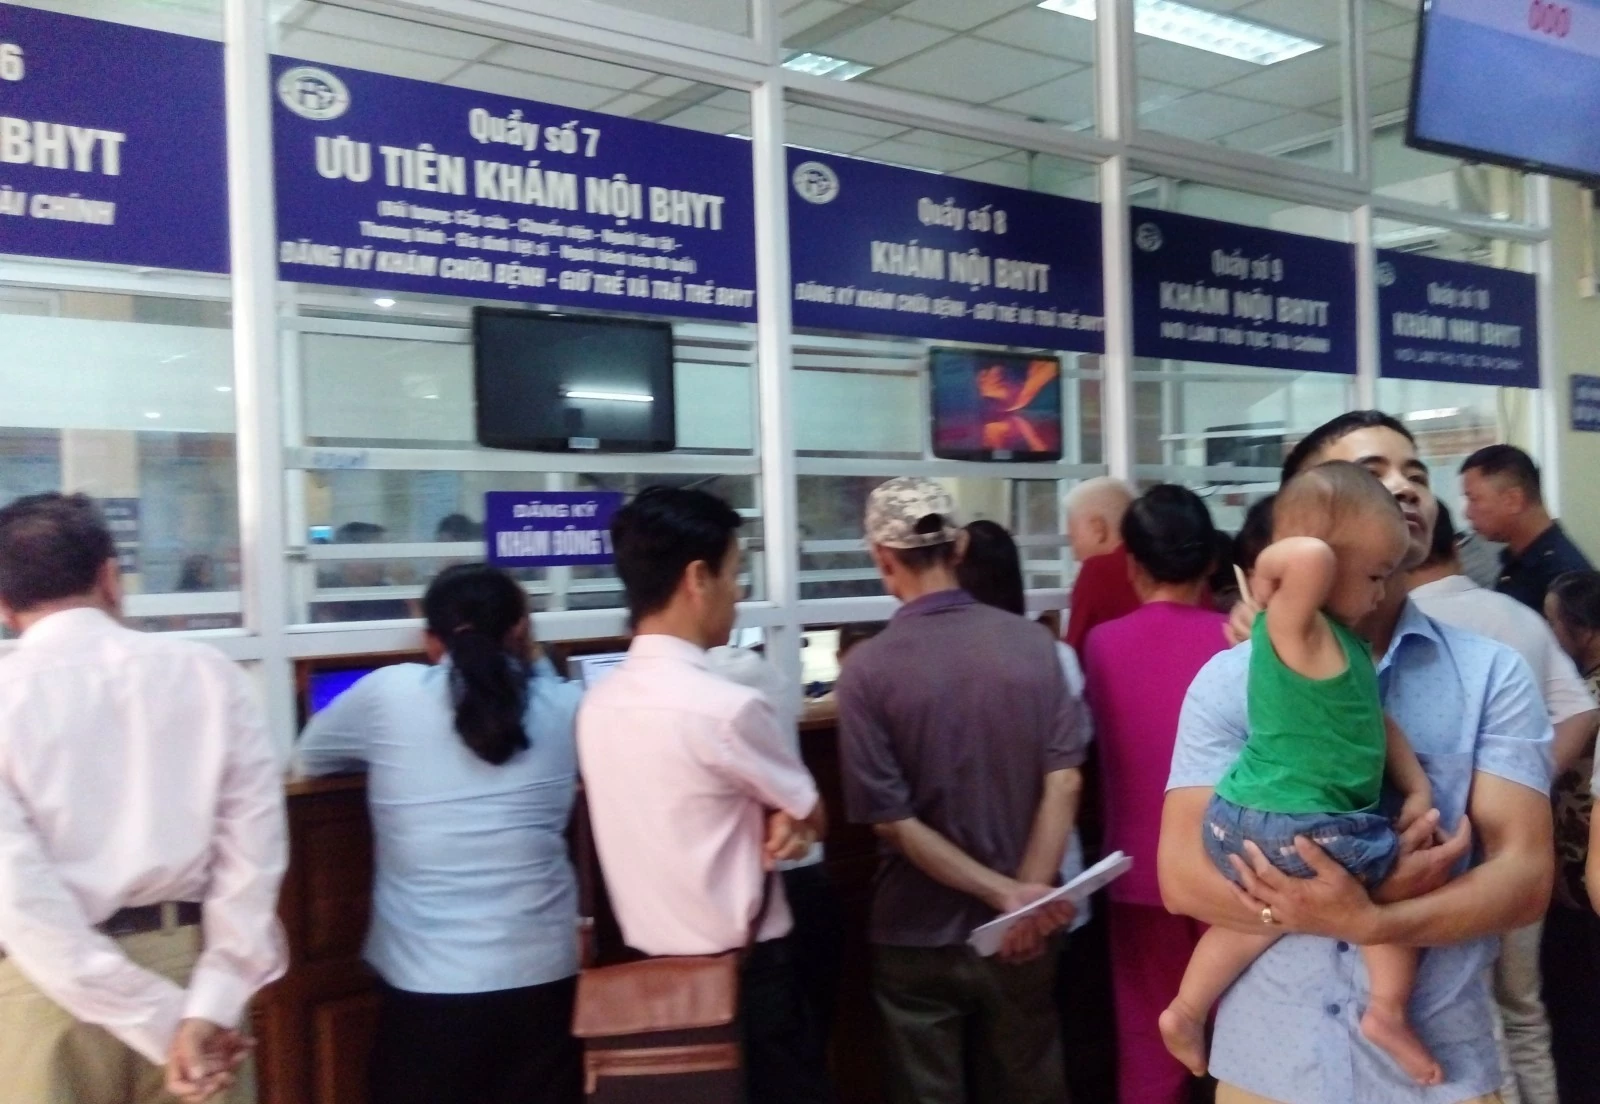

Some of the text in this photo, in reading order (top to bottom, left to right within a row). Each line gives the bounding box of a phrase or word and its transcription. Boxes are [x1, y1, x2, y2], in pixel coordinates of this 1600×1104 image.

[0, 43, 25, 81] 6
[0, 116, 126, 176] BHYT
[468, 107, 600, 157] Quầy số 7
[315, 135, 725, 231] ƯU TIÊN KHÁM NỘI BHYT
[917, 197, 965, 231] Quầy
[967, 203, 993, 233] số
[375, 249, 439, 277] KHÁM
[870, 239, 1051, 293] KHÁM NỘI BHYT
[1159, 279, 1230, 316] KHÁM
[1276, 296, 1330, 327] BHYT
[570, 500, 599, 518] KÝ
[495, 525, 551, 558] KHÁM
